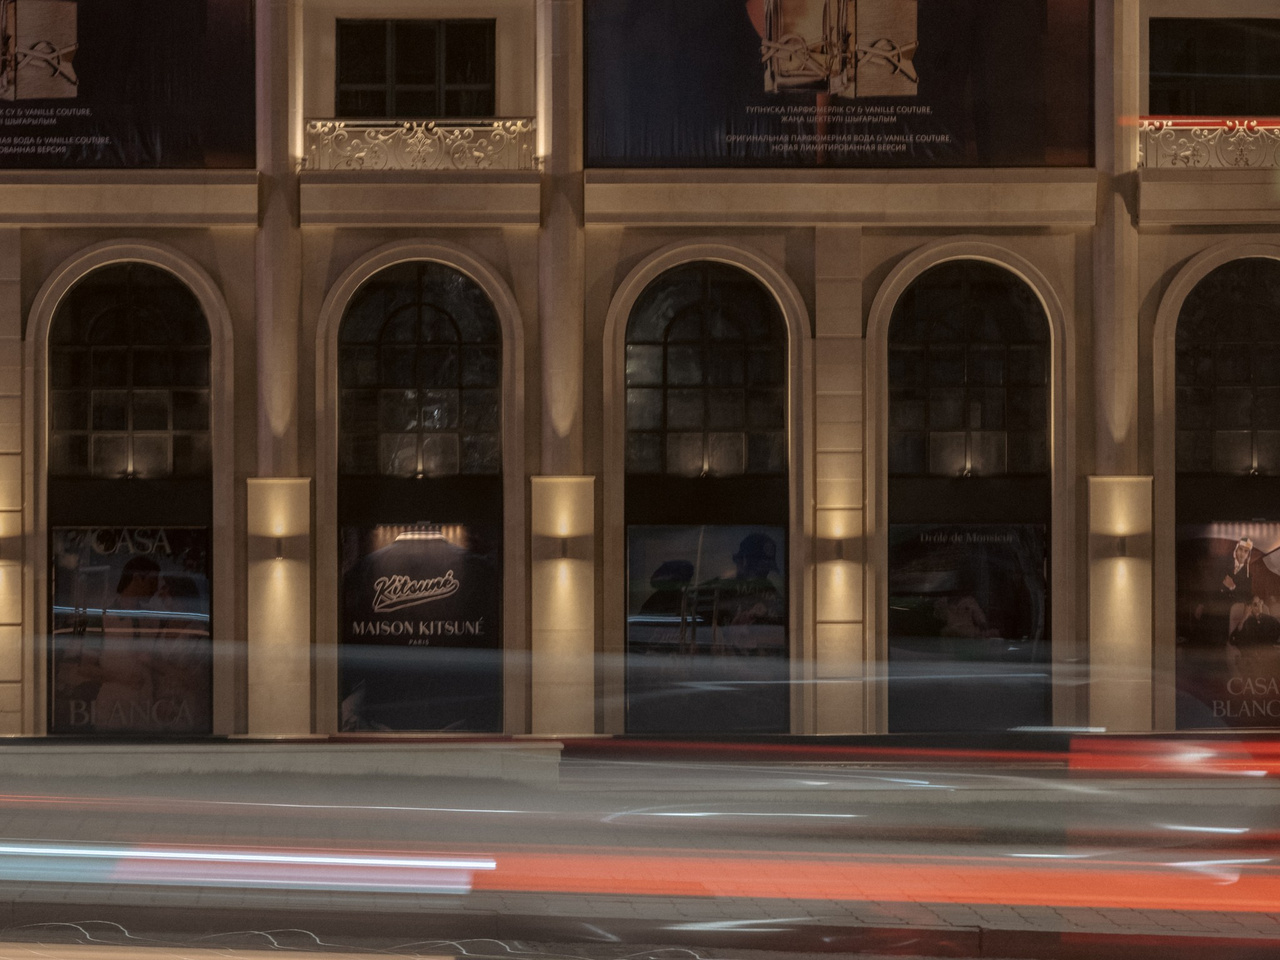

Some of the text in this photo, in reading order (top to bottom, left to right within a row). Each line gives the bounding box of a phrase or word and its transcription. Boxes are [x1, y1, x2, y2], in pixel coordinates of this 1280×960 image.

[25, 108, 54, 117] VANILLE
[865, 106, 894, 114] VANILLE
[13, 137, 35, 145] ВОДА
[44, 137, 74, 145] VANILLE
[726, 134, 789, 142] ОРИГИНАЛЬНАЯ
[791, 134, 851, 142] ПАРФЮМЕРНАЯ
[853, 134, 874, 142] ВОДА
[884, 134, 913, 142] VANILLE
[37, 146, 66, 154] ВЕРСИЯ
[91, 528, 172, 555] CASA
[951, 532, 963, 543] de
[352, 617, 485, 636] MAISON KITSUNÉ
[408, 638, 429, 646] PARIS
[1227, 677, 1280, 695] CASA
[69, 699, 194, 727] BLANCA
